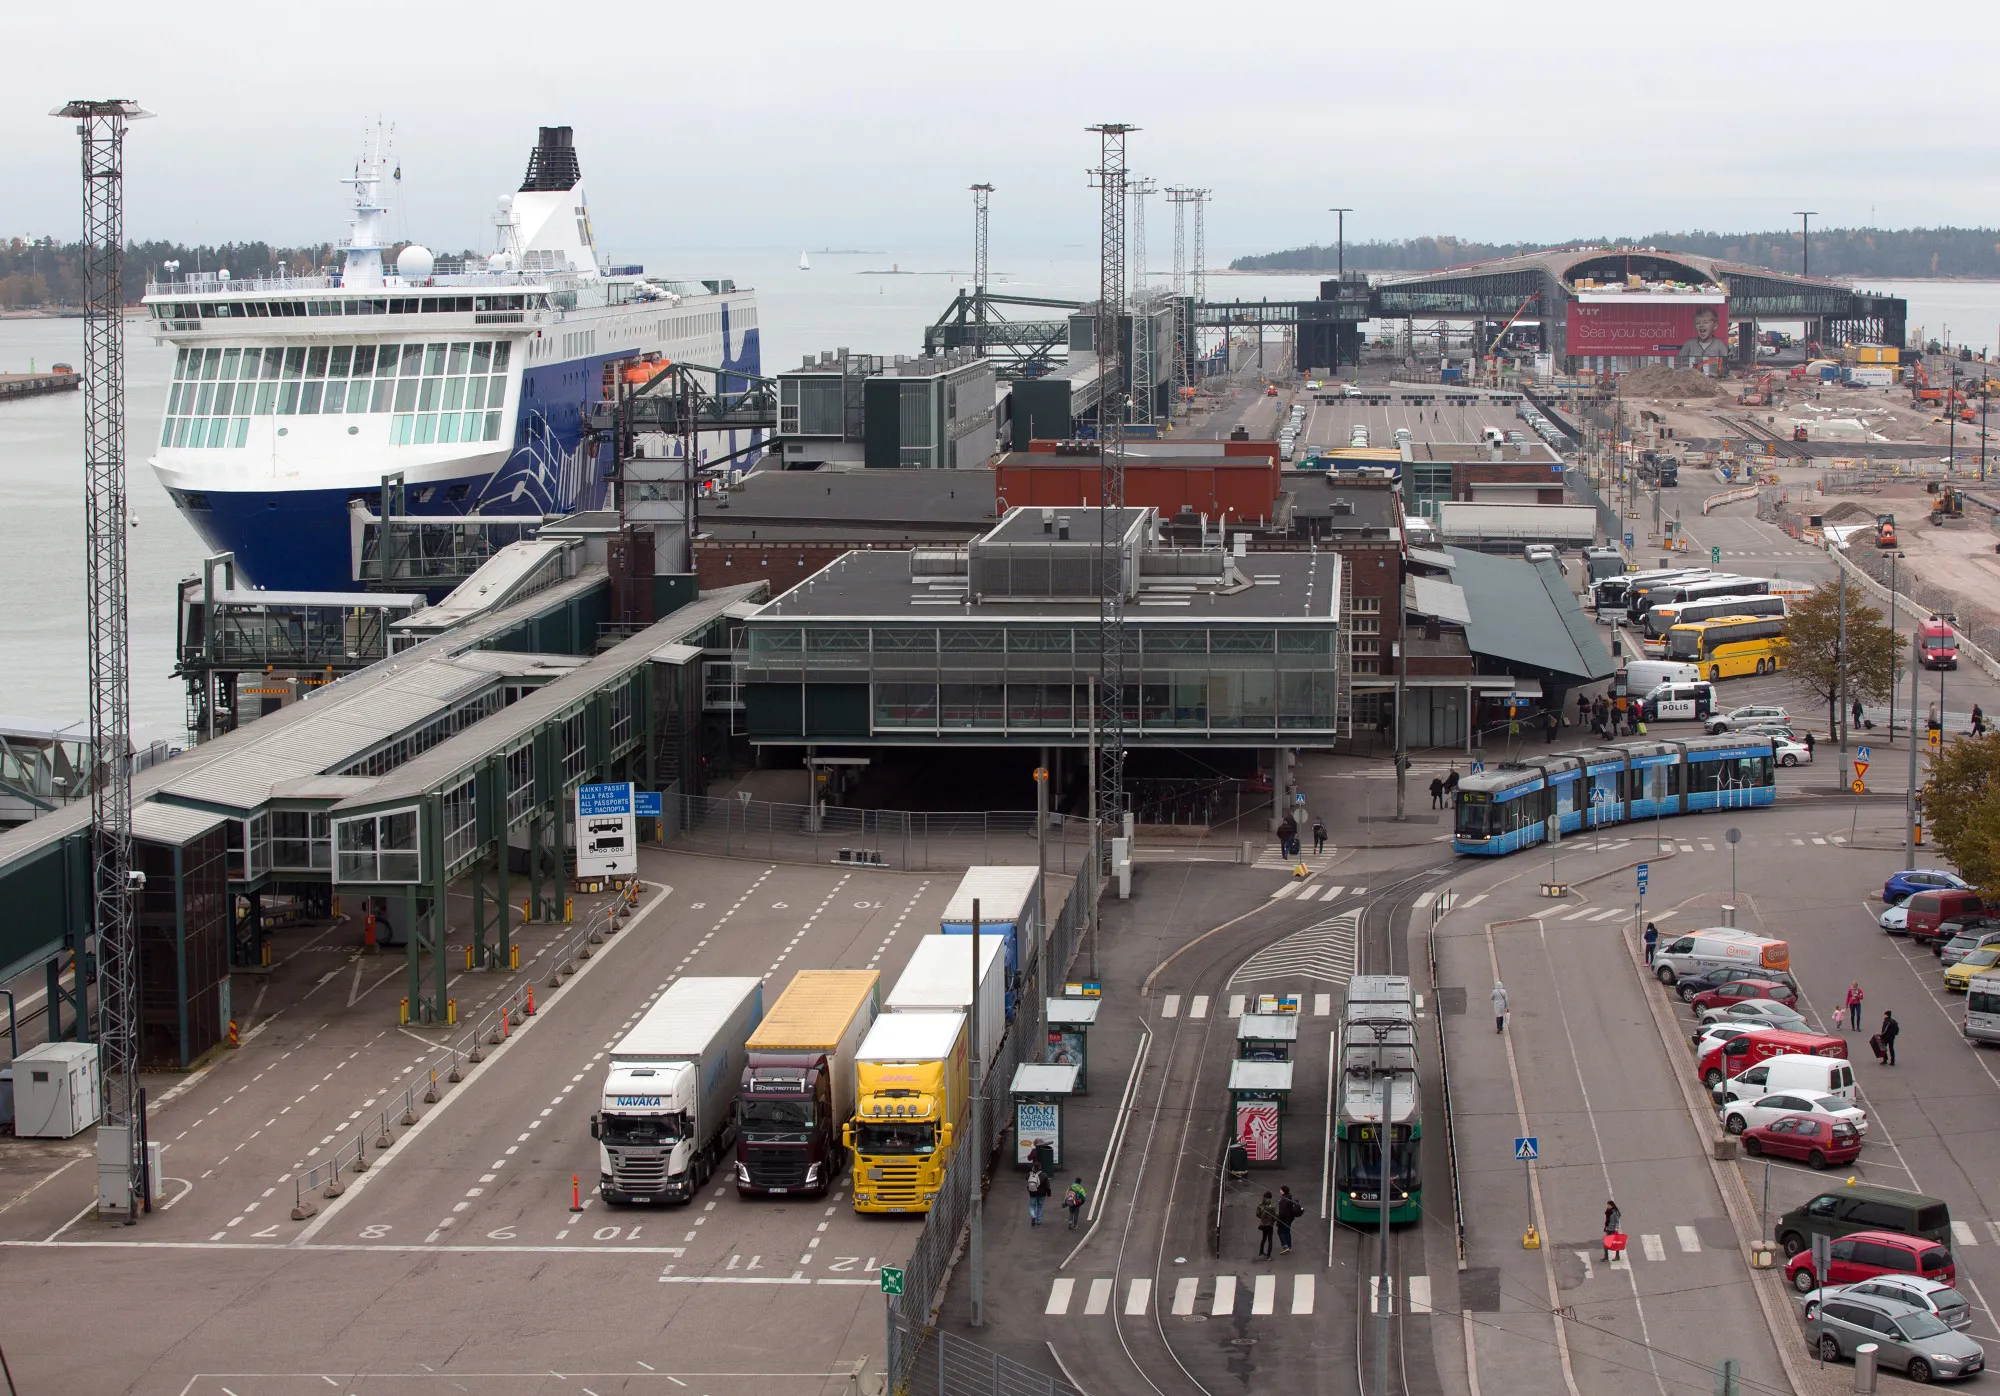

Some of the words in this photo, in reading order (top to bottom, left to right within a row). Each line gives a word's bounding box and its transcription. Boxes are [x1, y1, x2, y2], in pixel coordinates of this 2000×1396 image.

[1579, 325, 1606, 338] Sea
[1610, 328, 1635, 341] you
[1640, 326, 1675, 338] soon!
[617, 1096, 660, 1106] NAVAKA
[1020, 1106, 1055, 1115] KOKKI
[250, 1224, 279, 1237] 7
[359, 1224, 393, 1239] 8
[593, 1226, 643, 1241] 10
[726, 1255, 764, 1270] 11
[829, 1257, 893, 1271] 12
